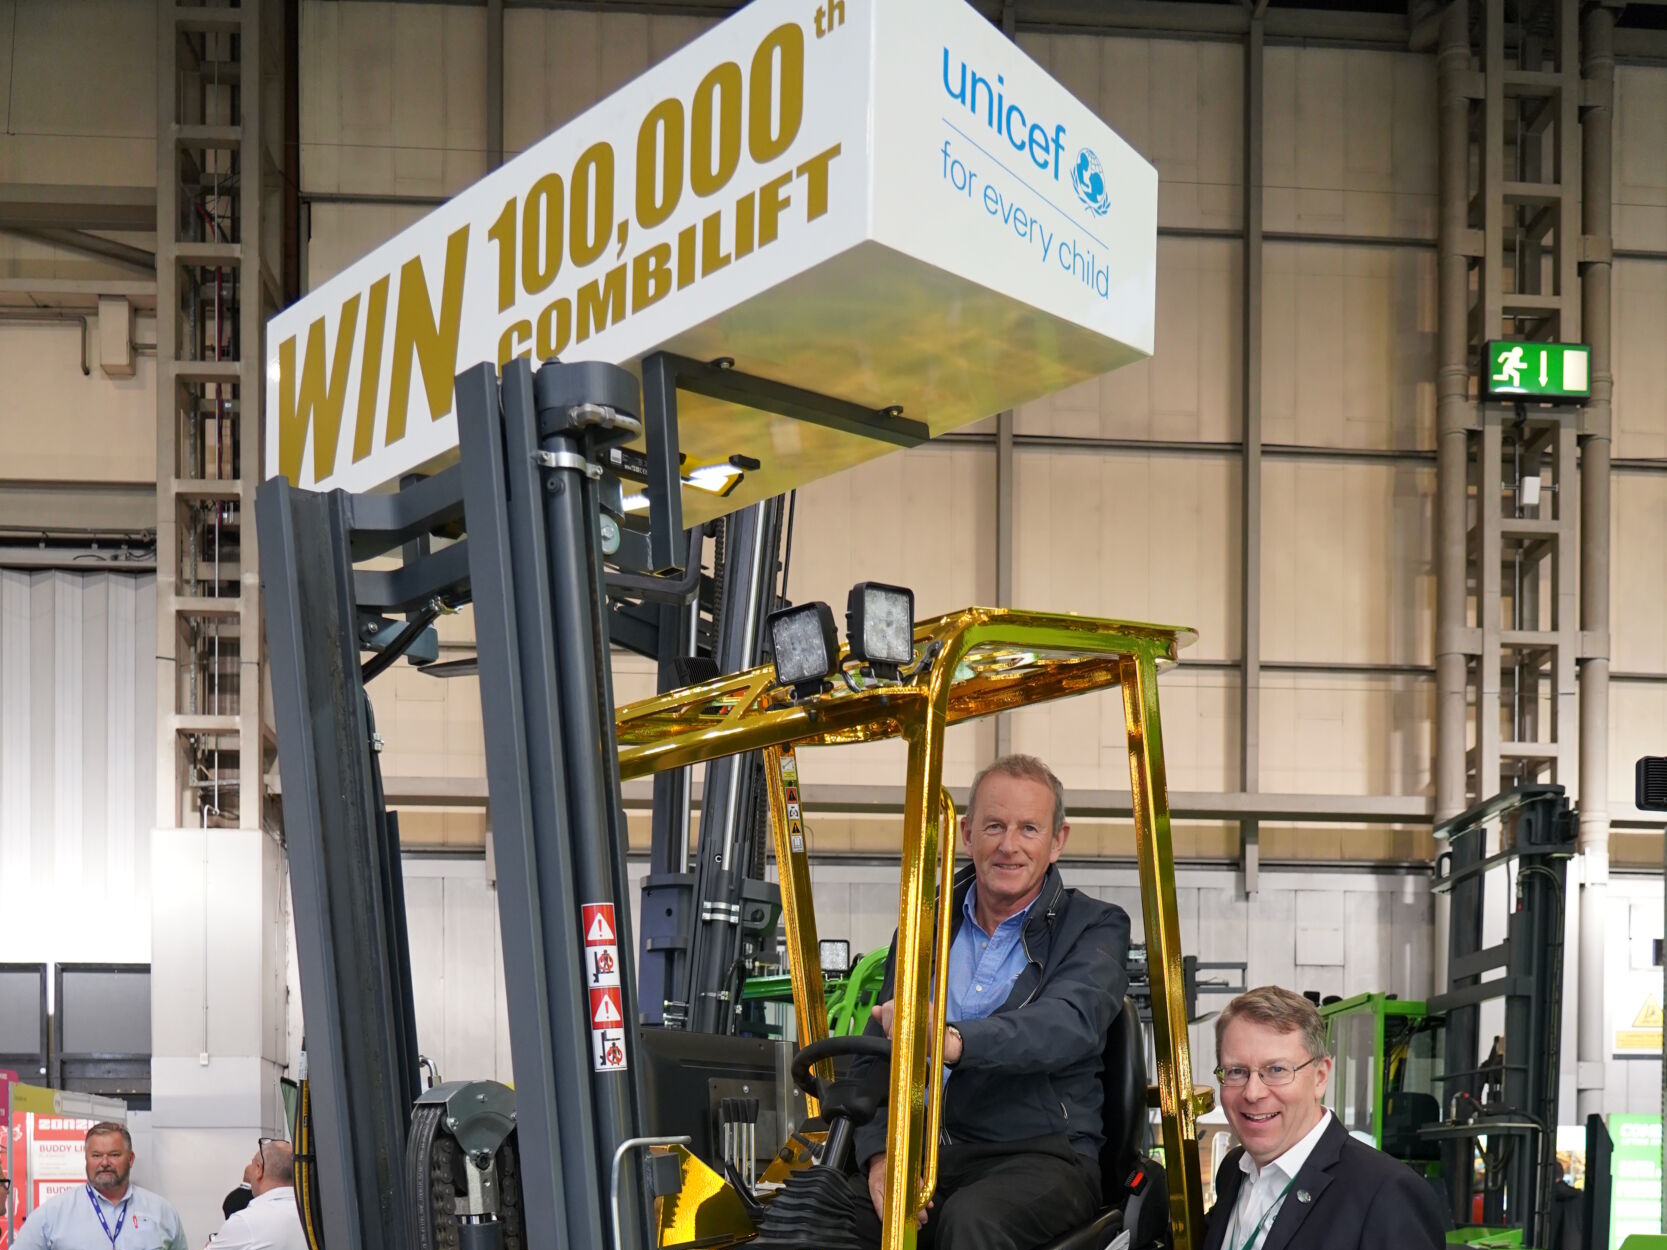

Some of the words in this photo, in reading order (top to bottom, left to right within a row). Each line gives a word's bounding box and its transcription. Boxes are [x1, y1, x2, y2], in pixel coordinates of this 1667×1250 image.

[943, 46, 1066, 181] unicef
[498, 142, 842, 378] COMBILIFT
[941, 140, 977, 198] for
[984, 184, 1053, 262] every
[1058, 239, 1109, 300] child
[279, 222, 470, 489] WIN
[40, 1144, 71, 1152] BUDDY
